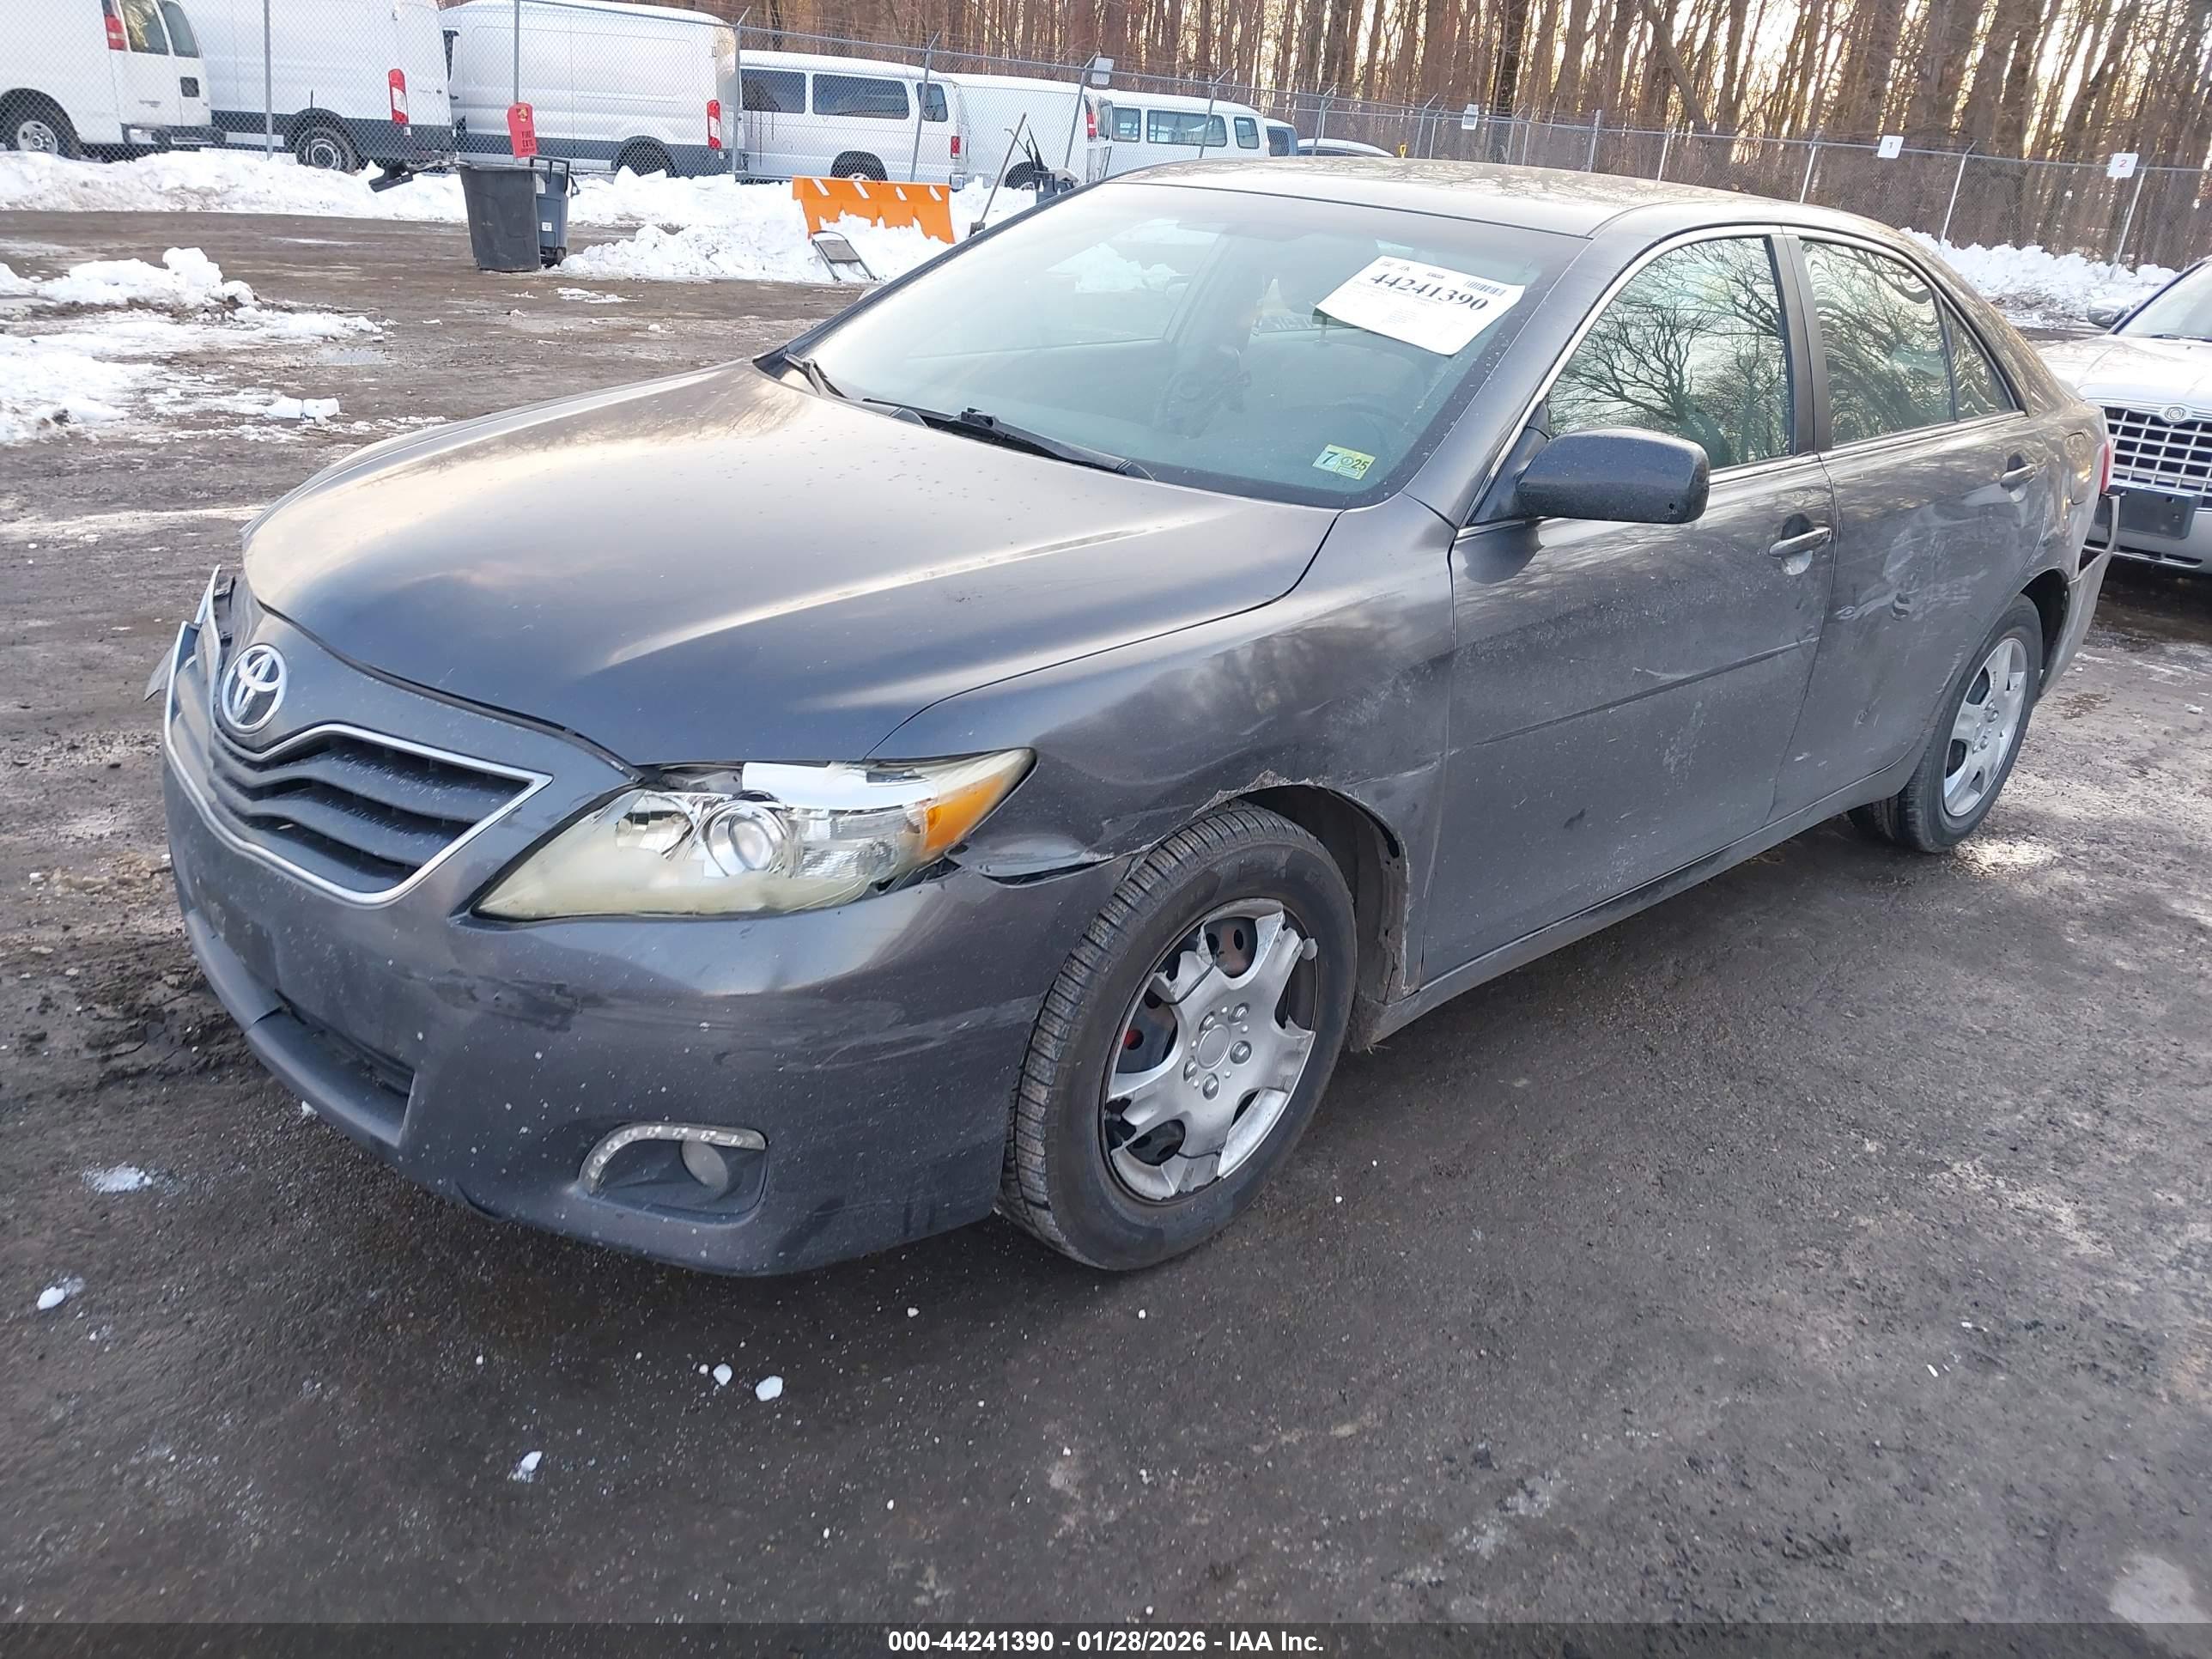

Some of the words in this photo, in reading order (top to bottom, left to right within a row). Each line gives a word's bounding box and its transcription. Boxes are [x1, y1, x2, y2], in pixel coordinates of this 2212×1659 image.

[2118, 159, 2127, 167] 2
[1370, 273, 1489, 311] 44241390
[1322, 451, 1339, 465] 7
[1351, 459, 1370, 471] 25
